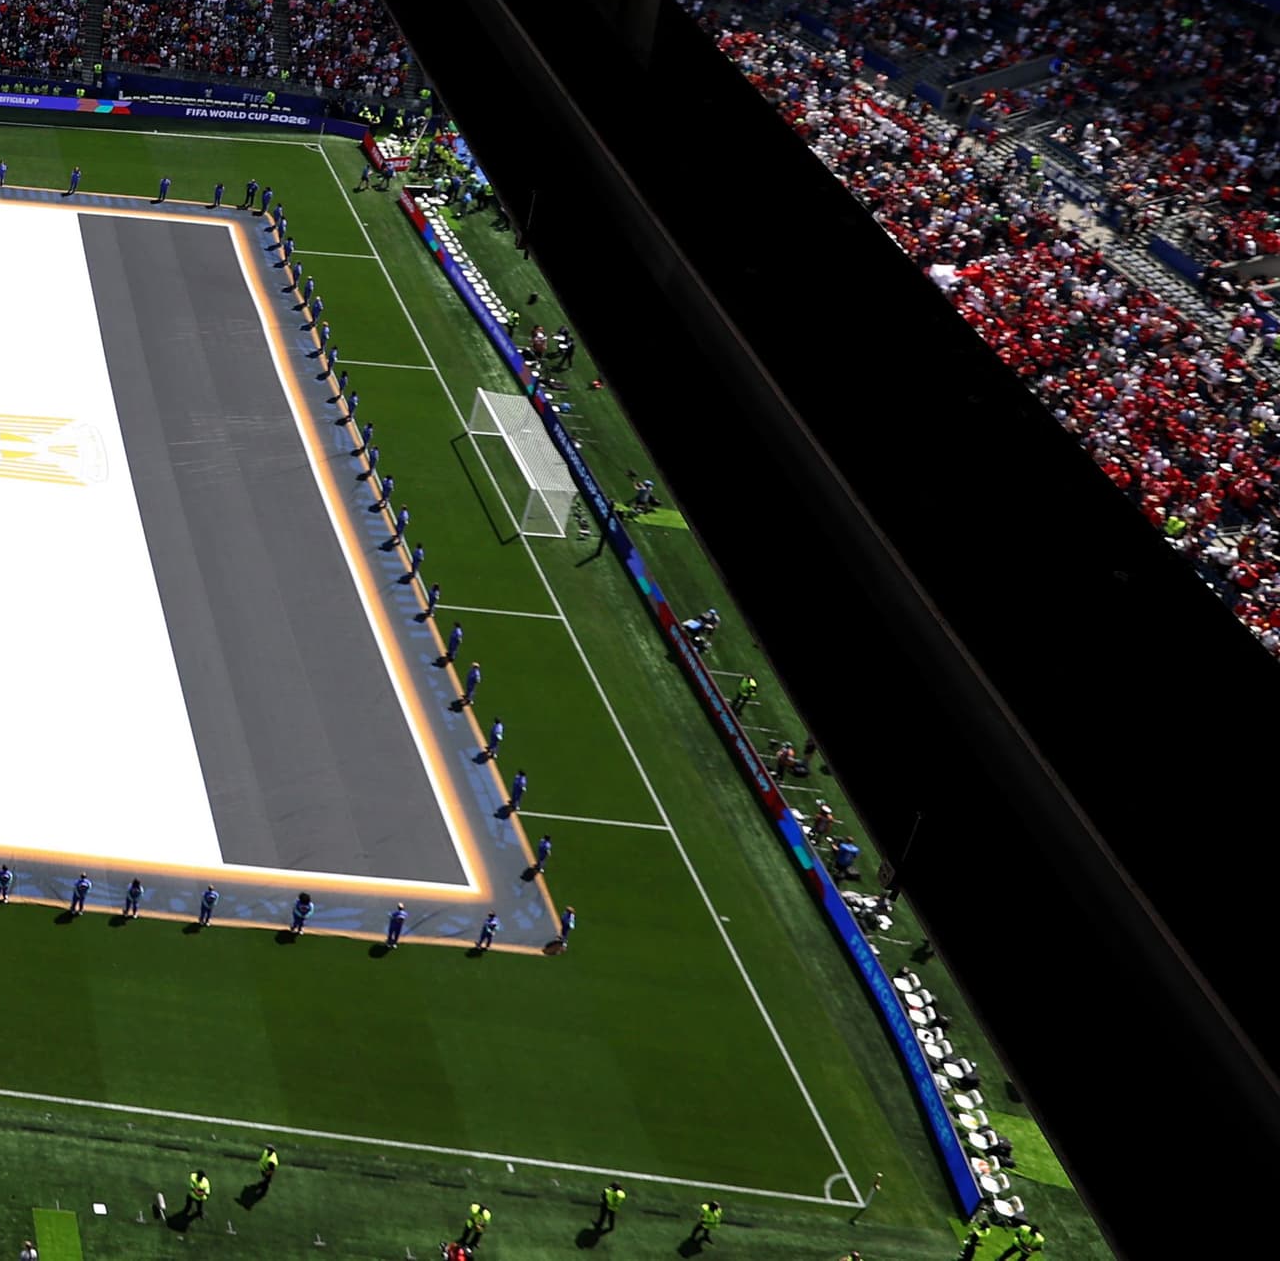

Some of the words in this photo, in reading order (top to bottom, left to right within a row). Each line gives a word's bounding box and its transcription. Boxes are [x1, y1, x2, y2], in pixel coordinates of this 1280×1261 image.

[186, 108, 209, 118] FIFA
[209, 109, 247, 120] WORLD
[248, 112, 270, 121] CUP
